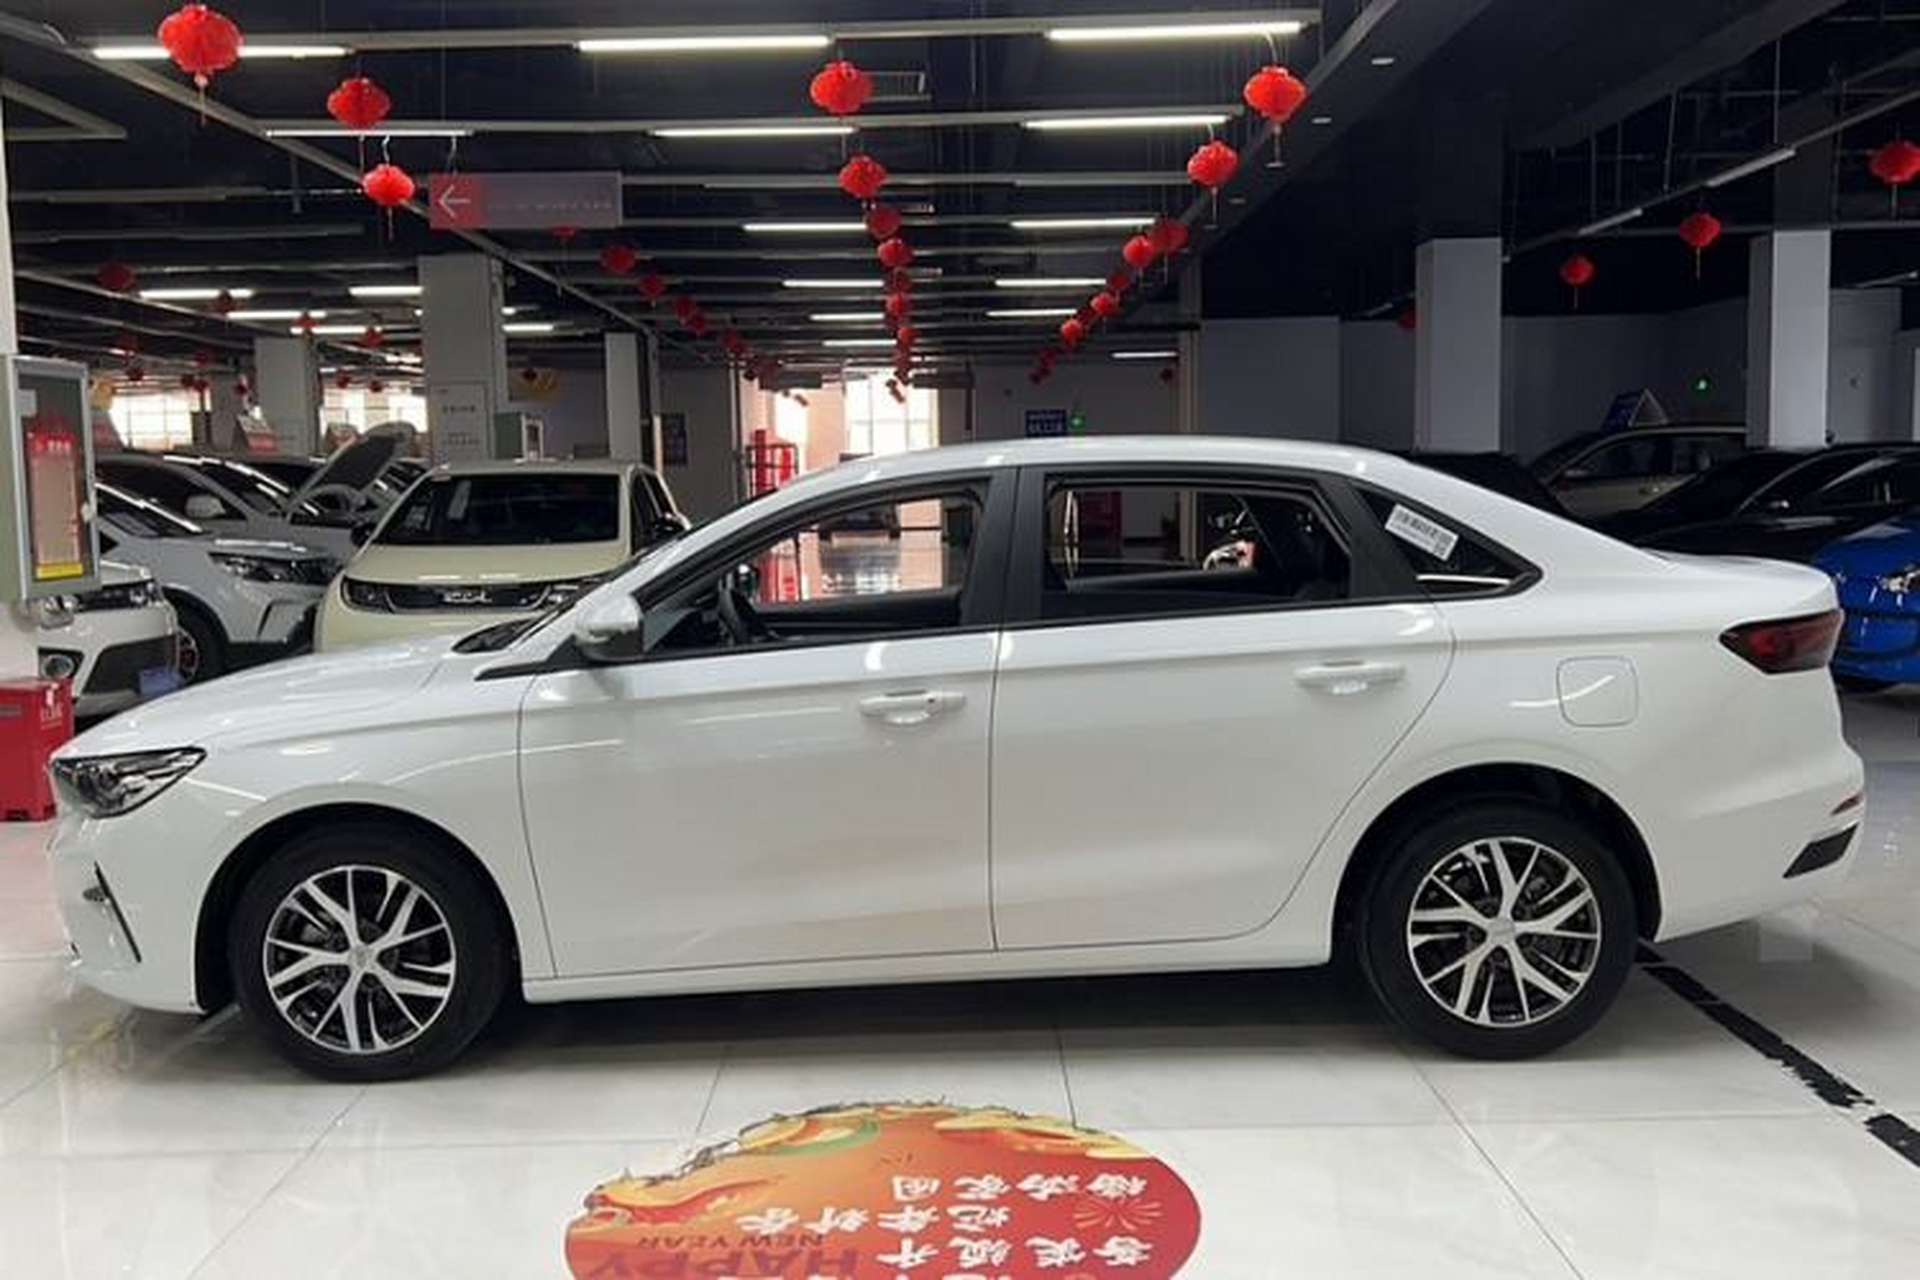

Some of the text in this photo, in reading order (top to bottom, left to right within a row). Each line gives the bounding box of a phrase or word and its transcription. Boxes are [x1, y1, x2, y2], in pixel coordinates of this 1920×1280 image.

[637, 1235, 823, 1250] NEW YEAR
[588, 1250, 860, 1280] HAPPY
